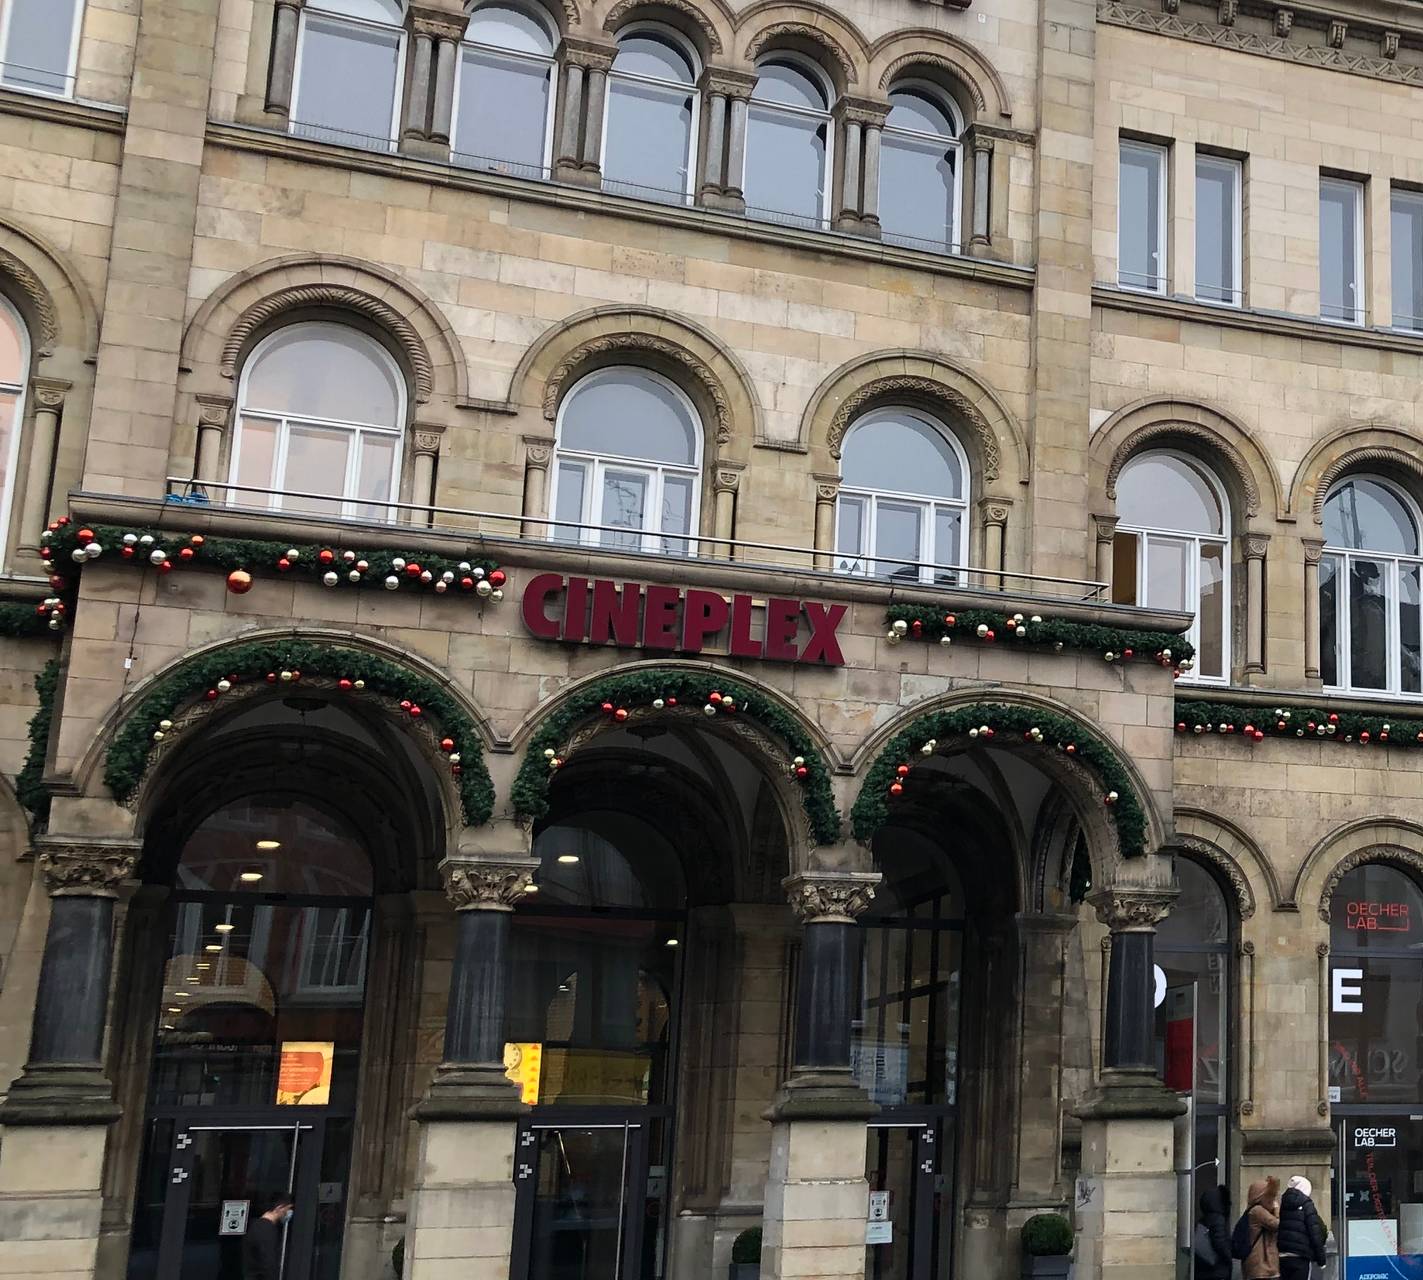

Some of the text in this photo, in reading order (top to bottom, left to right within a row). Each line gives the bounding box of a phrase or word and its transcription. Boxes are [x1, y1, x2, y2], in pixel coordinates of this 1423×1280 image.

[522, 574, 848, 666] CINEPLEX
[1347, 903, 1409, 916] OECHER
[1347, 916, 1377, 930] LAB
[1354, 1128, 1397, 1138] OECHER
[1354, 1137, 1376, 1147] LAB
